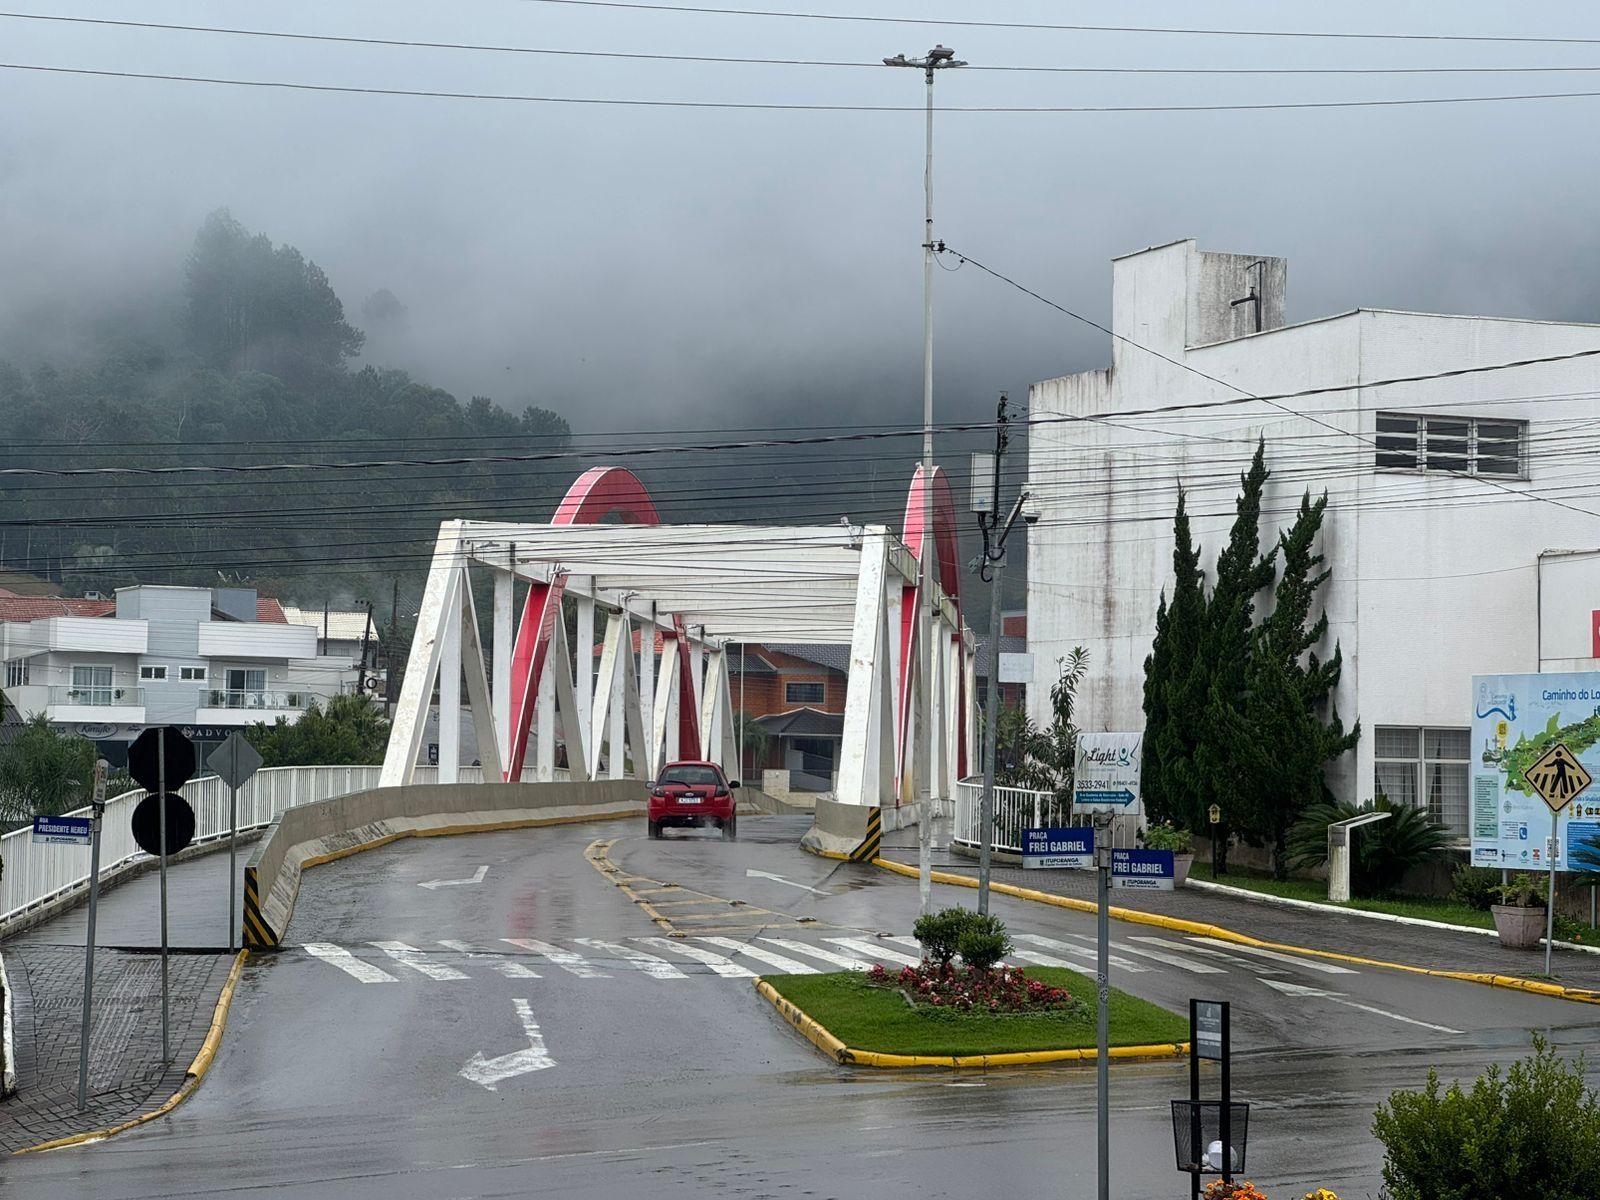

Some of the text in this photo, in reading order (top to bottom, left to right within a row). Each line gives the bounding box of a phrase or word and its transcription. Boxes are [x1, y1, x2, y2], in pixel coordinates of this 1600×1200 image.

[1542, 689, 1577, 701] Caminho
[1578, 689, 1589, 700] do
[1087, 748, 1117, 765] Light
[1077, 780, 1109, 789] 3533-2941
[39, 824, 88, 834] PRESIDENTE NEREU
[1029, 831, 1048, 841] PRAÇA
[1029, 841, 1087, 852] FREI GABRIEL
[1113, 851, 1130, 861] PRAÇA
[1113, 862, 1164, 874] FREI GABRIEL
